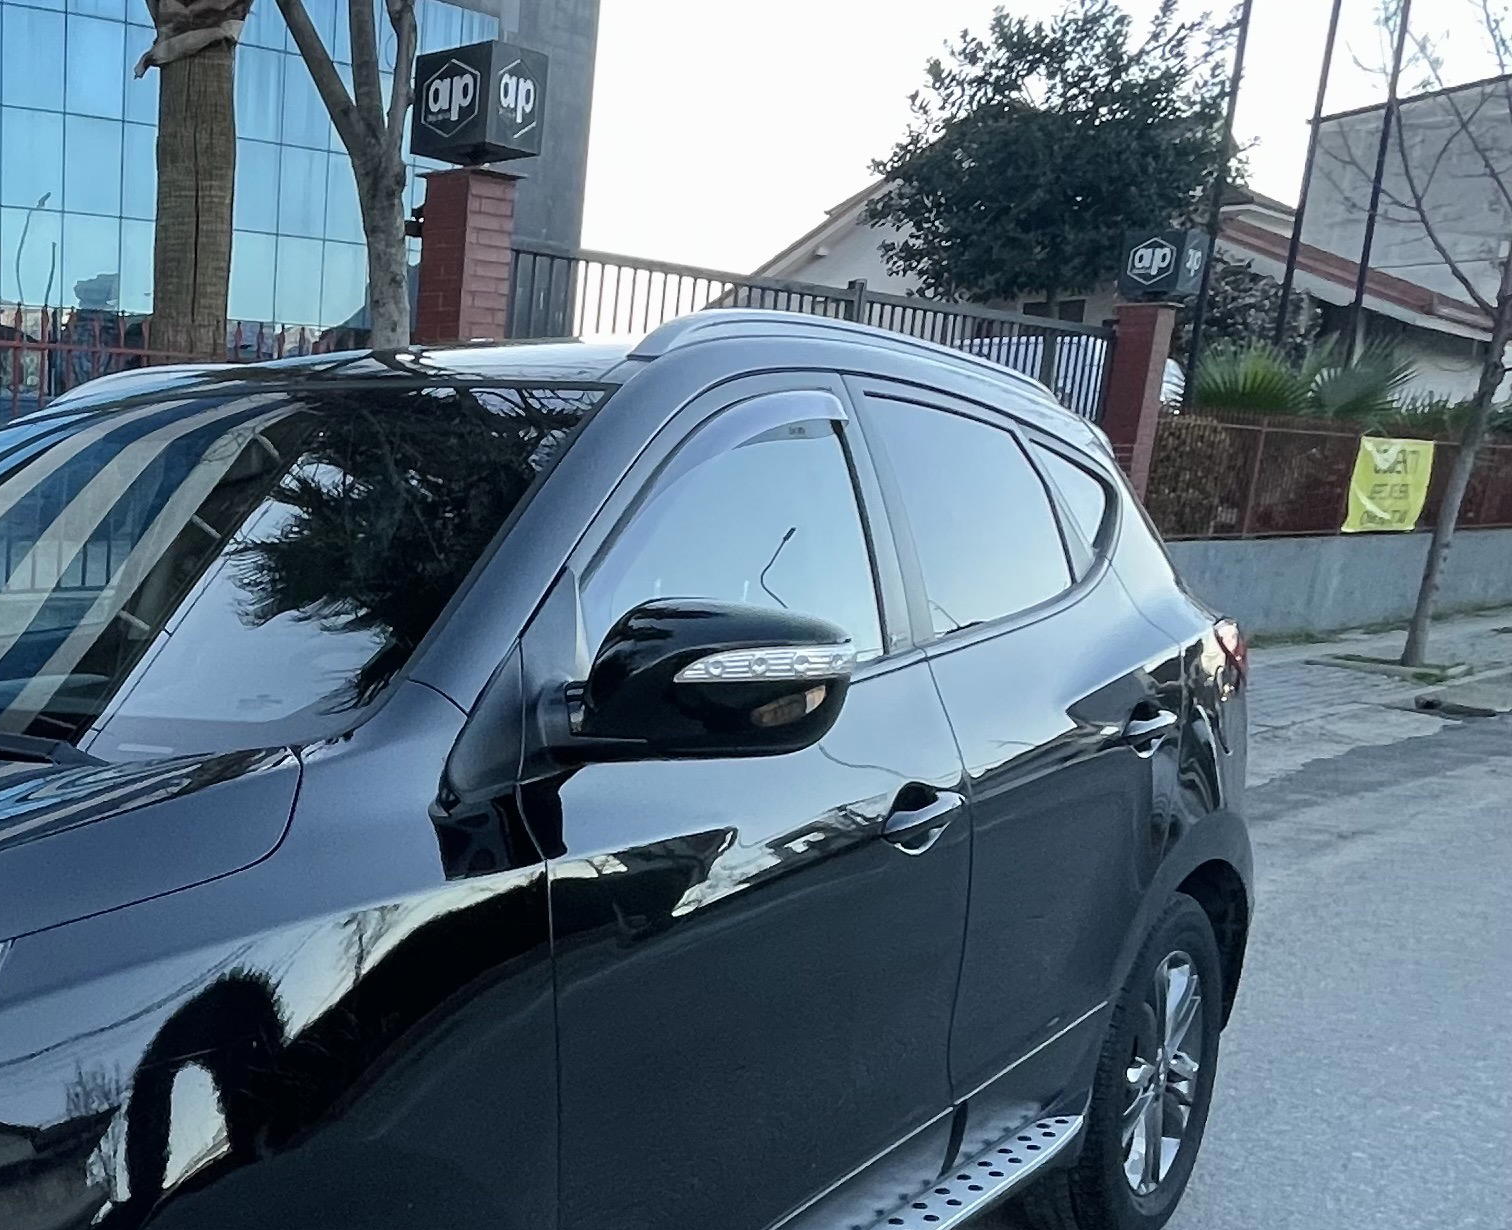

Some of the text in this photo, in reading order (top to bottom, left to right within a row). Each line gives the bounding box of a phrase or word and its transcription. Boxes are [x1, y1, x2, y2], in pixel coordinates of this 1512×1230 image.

[428, 74, 474, 121] ap
[500, 73, 535, 123] ap
[1134, 248, 1172, 276] ap
